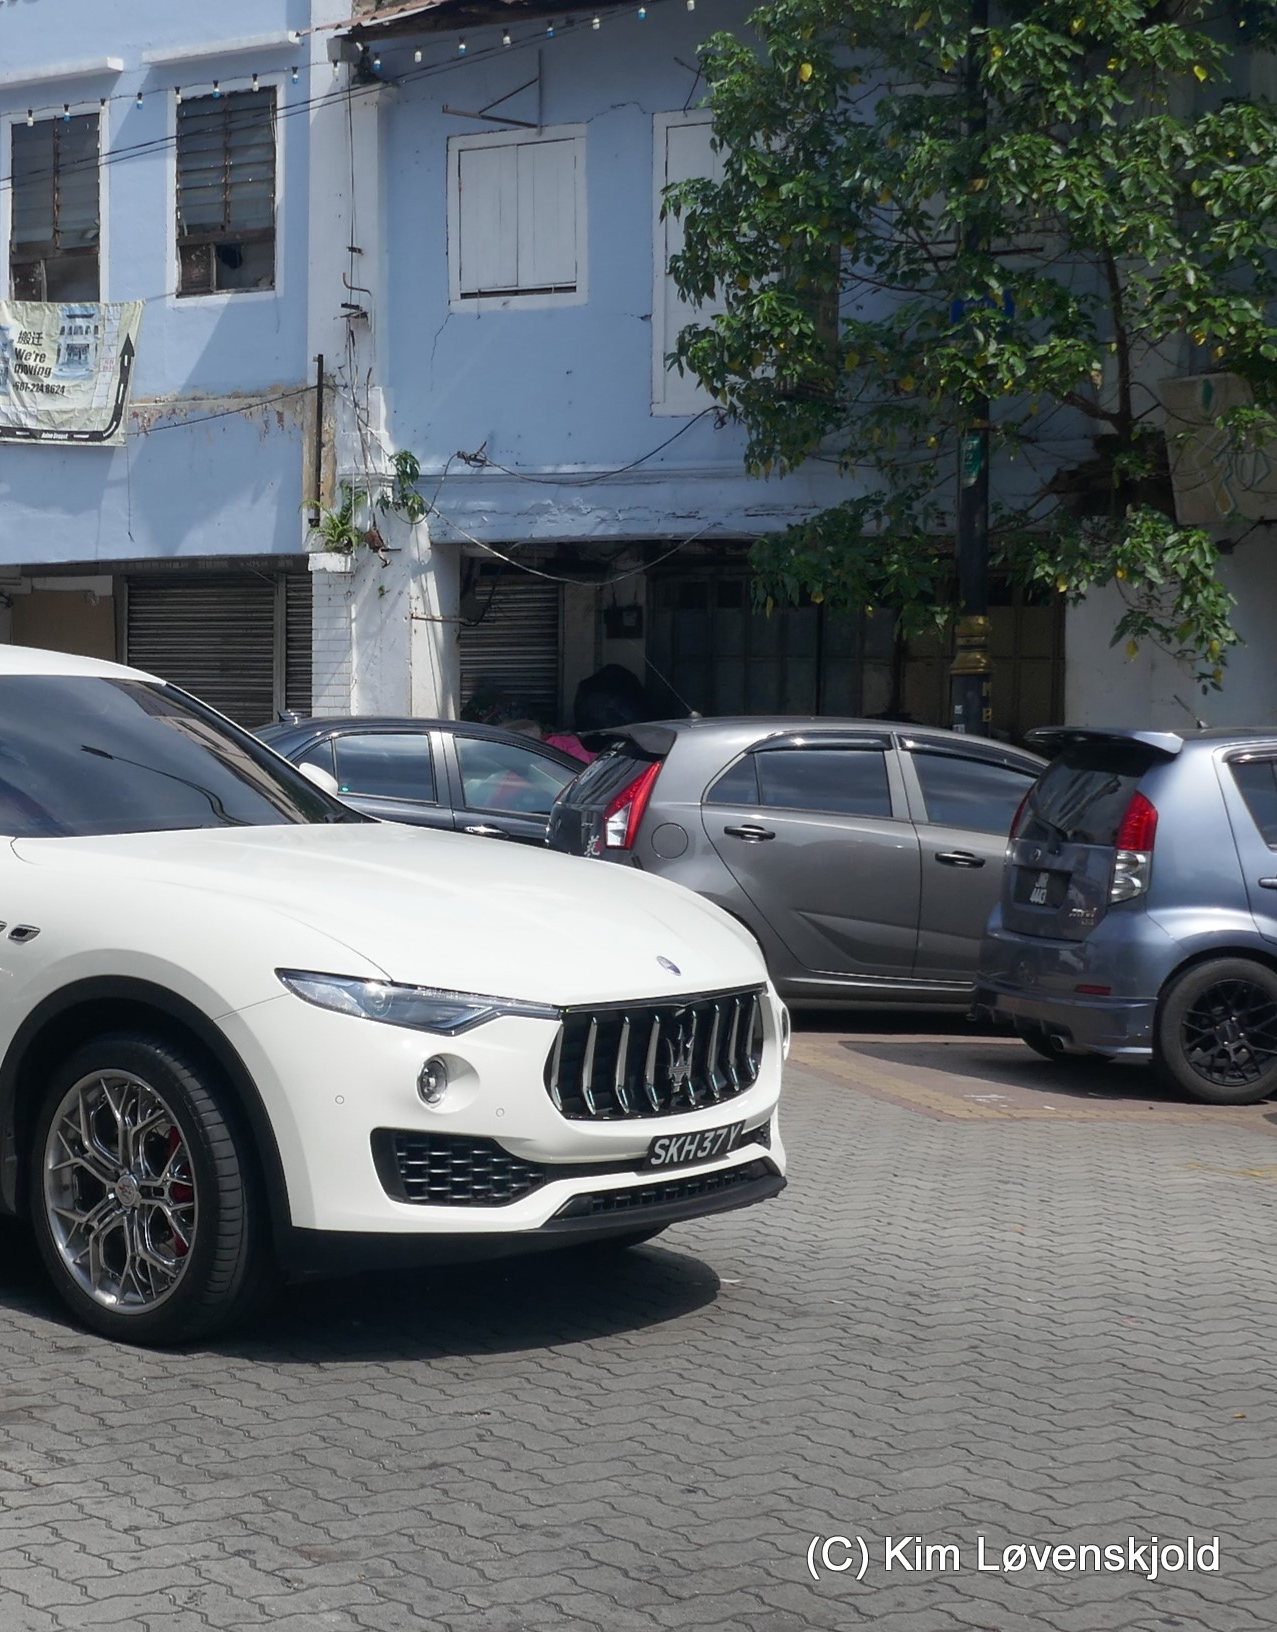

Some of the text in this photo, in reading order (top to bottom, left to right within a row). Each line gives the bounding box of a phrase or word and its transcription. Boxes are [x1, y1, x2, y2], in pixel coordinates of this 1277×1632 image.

[14, 348, 47, 363] We're
[14, 363, 52, 378] moving
[650, 1123, 742, 1166] SKH37Y
